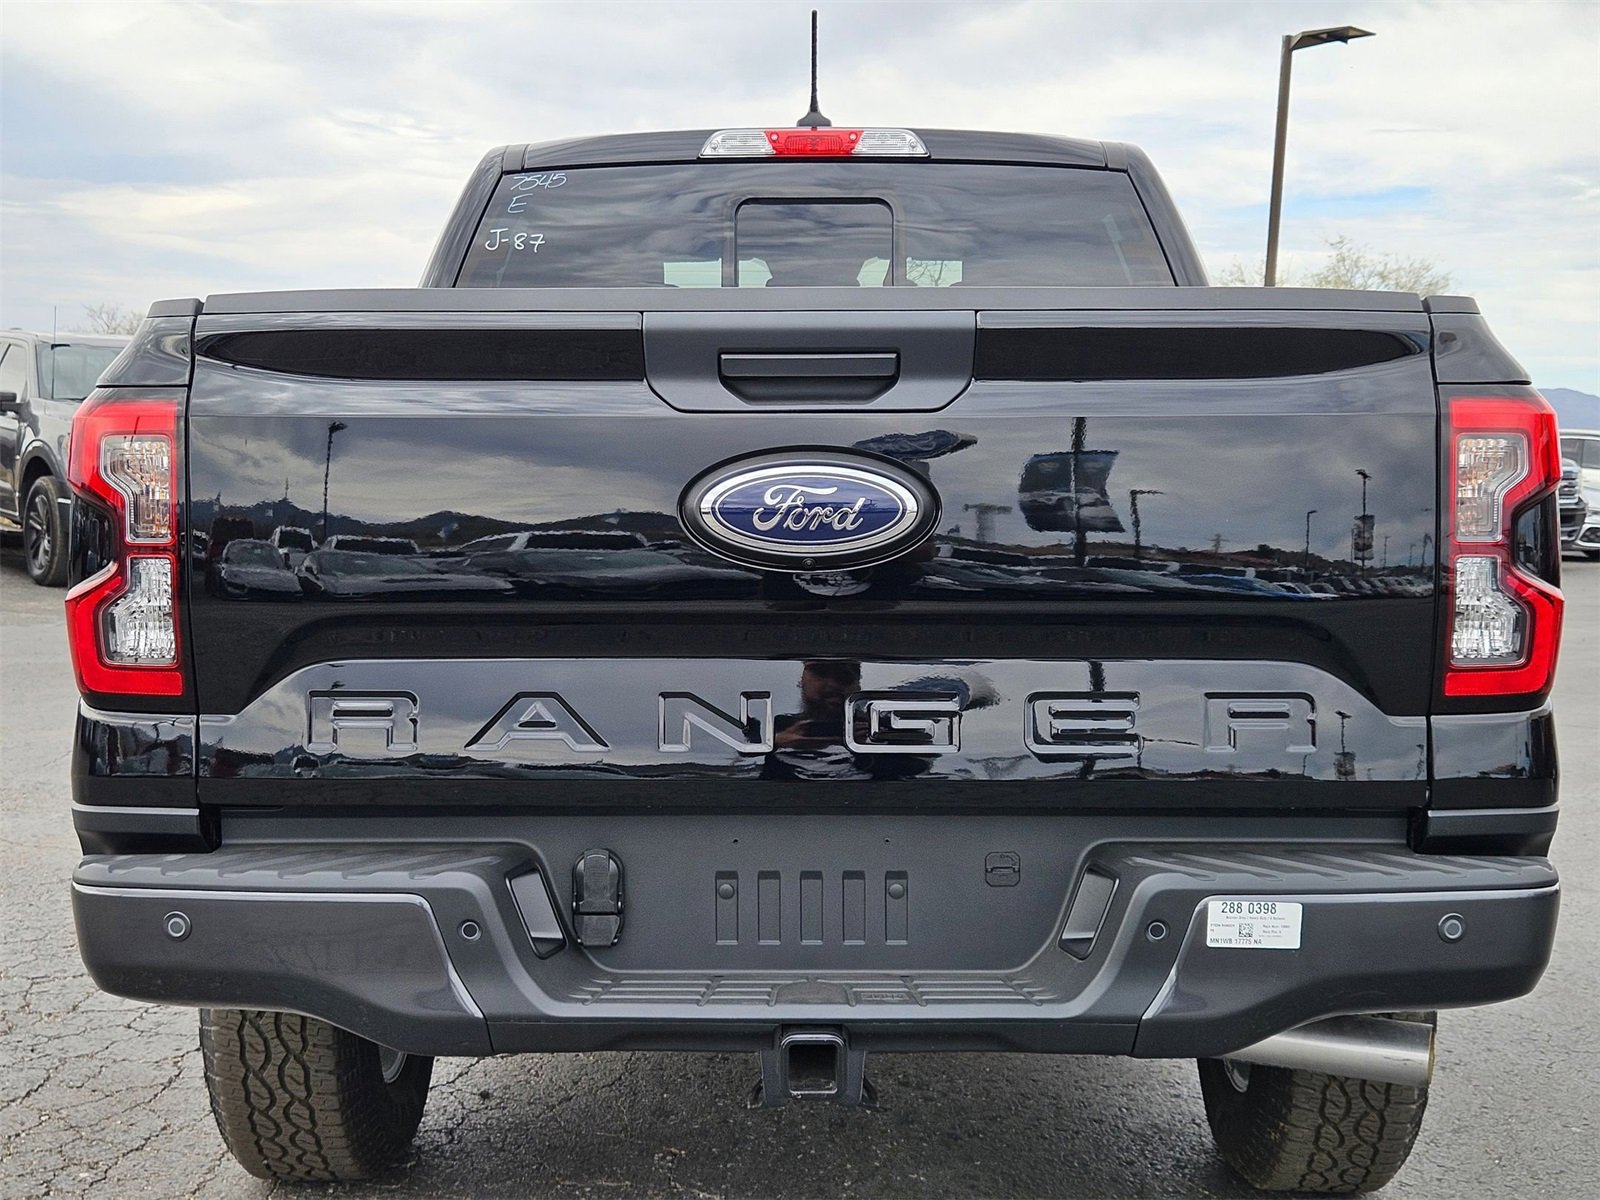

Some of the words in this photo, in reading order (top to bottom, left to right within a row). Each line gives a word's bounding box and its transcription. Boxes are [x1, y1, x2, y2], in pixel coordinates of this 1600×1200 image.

[508, 194, 534, 213] E
[485, 228, 546, 253] J-87
[753, 484, 866, 531] Ford
[306, 689, 1319, 755] RANGER
[1221, 902, 1243, 914] 288
[1248, 902, 1277, 915] 0398
